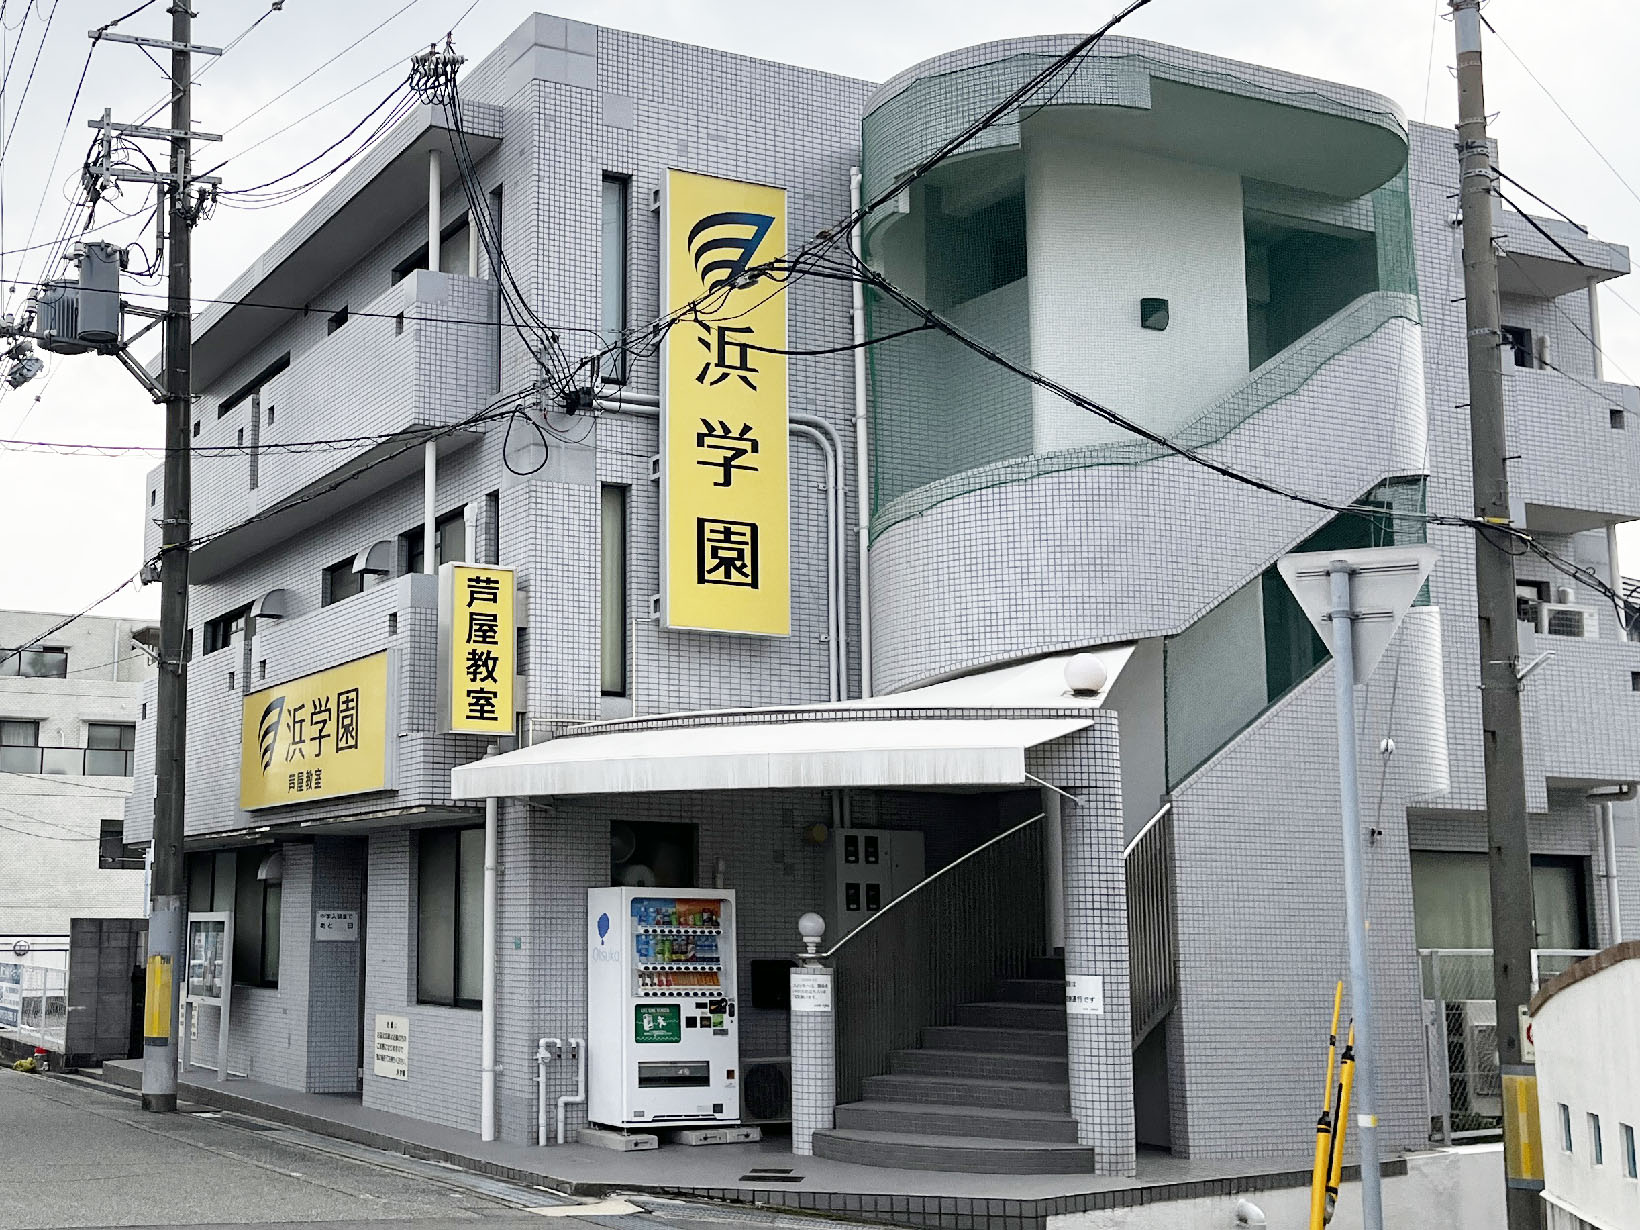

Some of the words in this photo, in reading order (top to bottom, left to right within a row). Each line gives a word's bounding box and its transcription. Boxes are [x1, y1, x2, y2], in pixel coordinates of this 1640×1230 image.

[695, 322, 759, 590] 浜学園
[466, 576, 500, 721] 芦屋教室
[285, 687, 359, 763] 浜学園
[287, 768, 322, 793] 芦屋教室
